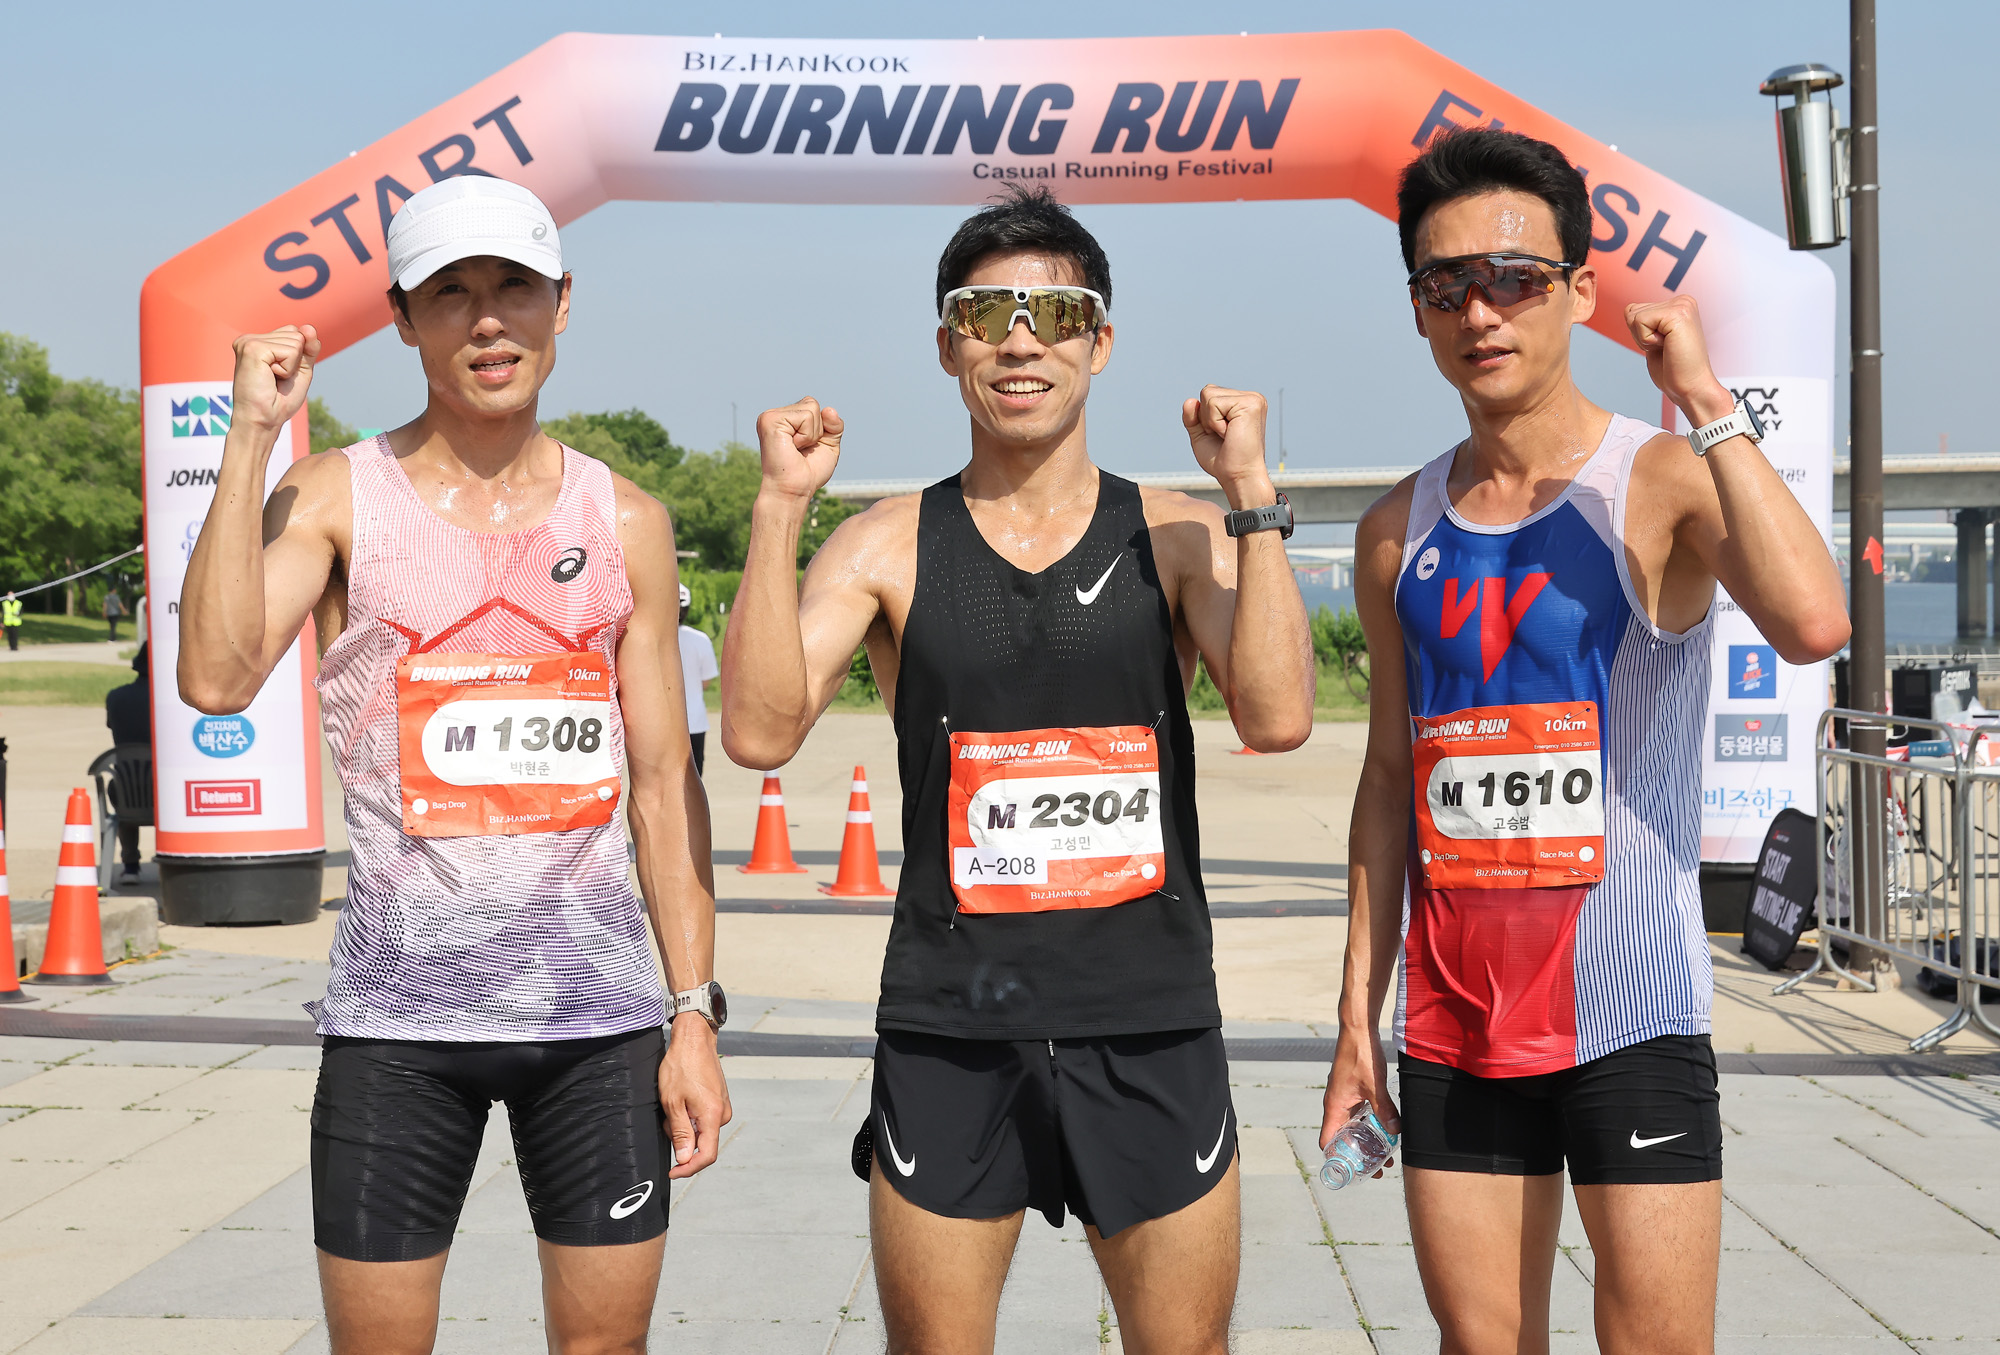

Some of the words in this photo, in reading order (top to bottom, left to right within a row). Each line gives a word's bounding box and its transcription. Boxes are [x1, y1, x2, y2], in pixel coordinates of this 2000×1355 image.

[654, 82, 1075, 156] BURNING
[1091, 78, 1301, 154] RUN
[973, 162, 1057, 180] Casual
[1065, 161, 1169, 182] Running
[1177, 158, 1273, 178] Festival
[264, 95, 534, 300] START
[1411, 89, 1707, 292] FSH
[410, 665, 492, 682] BURNING
[493, 664, 533, 680] RUN
[568, 668, 601, 681] 10km
[475, 679, 501, 687] Running
[502, 678, 527, 686] Festival
[1476, 718, 1510, 734] RUN
[1544, 719, 1587, 732] 10km
[198, 732, 249, 751] 백산수
[444, 725, 476, 752] M
[493, 716, 603, 753] 1308
[1443, 735, 1460, 743] Casual
[1460, 734, 1484, 742] Running
[958, 742, 1031, 760] BURNING
[1033, 740, 1071, 756] RUN
[1108, 740, 1147, 754] 10km
[1720, 735, 1784, 757] 동원샘물
[993, 758, 1014, 766] Casual
[1015, 757, 1042, 765] Running
[1043, 755, 1068, 763] Festival
[510, 761, 551, 776] 박현준
[1441, 781, 1463, 807] M
[1478, 768, 1593, 807] 1610
[200, 790, 243, 804] Returns
[560, 796, 576, 804] Race
[432, 802, 448, 811] Bag
[449, 800, 467, 810] Drop
[987, 803, 1017, 830] M
[1029, 788, 1149, 829] 2304
[1493, 816, 1529, 831] 고승범
[1050, 836, 1091, 851] 고성민
[1445, 853, 1459, 862] Drop
[1540, 851, 1557, 859] Race
[1557, 850, 1575, 858] Pack
[968, 856, 1036, 876] A-208
[1103, 870, 1119, 878] Race
[1120, 868, 1138, 877] Pack
